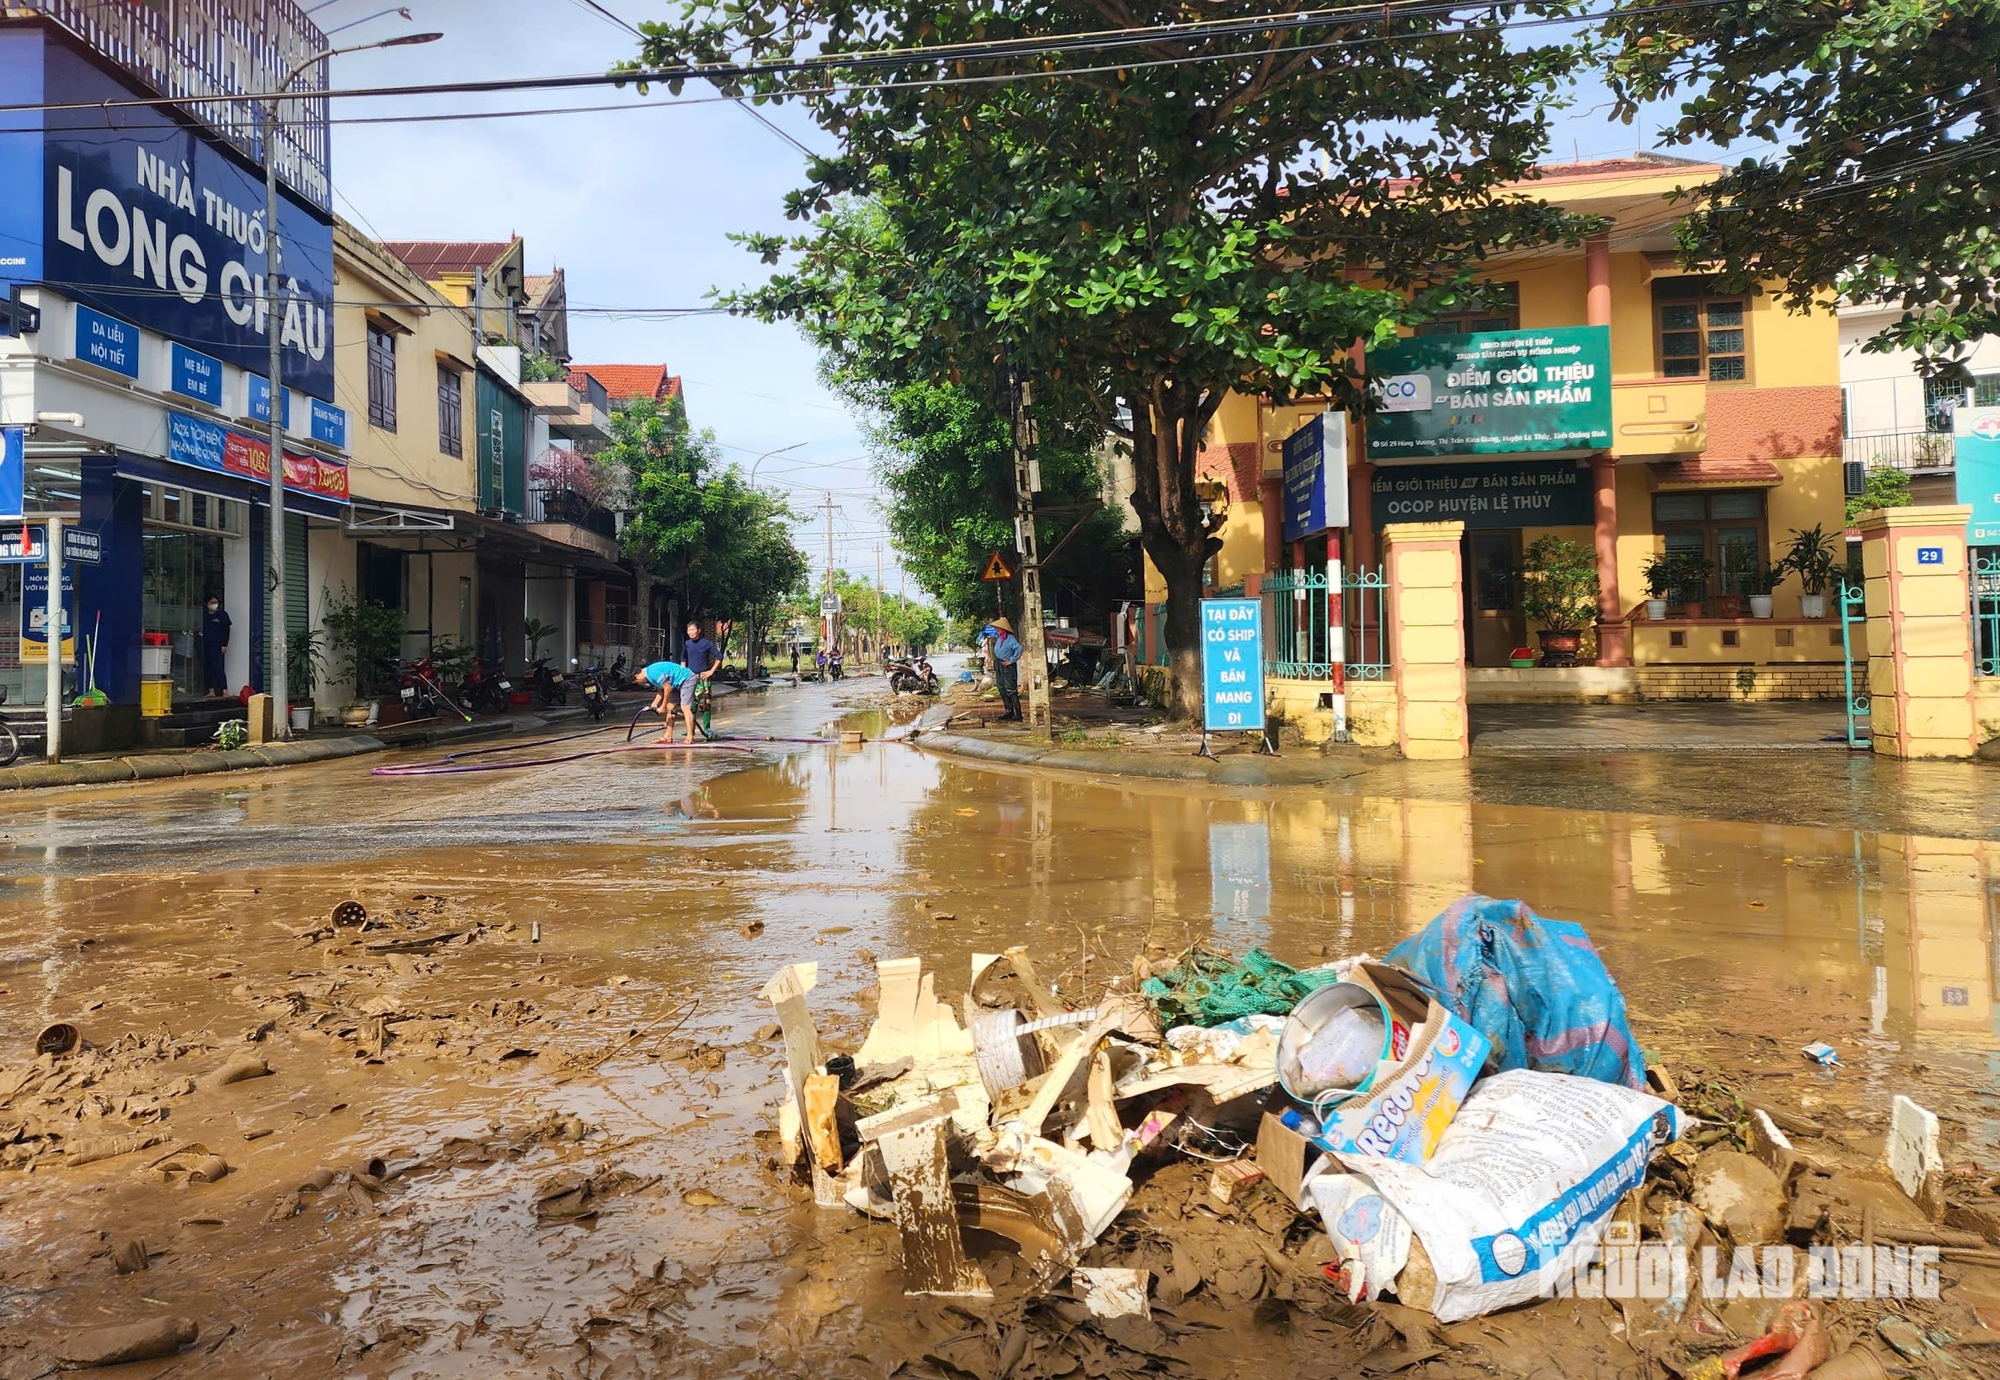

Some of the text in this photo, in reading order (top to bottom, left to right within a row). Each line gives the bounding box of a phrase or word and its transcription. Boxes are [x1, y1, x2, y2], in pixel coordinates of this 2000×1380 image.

[137, 146, 197, 217] NHÀ
[58, 165, 326, 361] LONG CHÂU
[92, 321, 125, 344] DA LIỄU
[91, 343, 126, 367] NỘI TIẾT
[1456, 352, 1480, 360] TRUNG
[1481, 350, 1497, 359] TÂM
[1497, 350, 1517, 359] DỊCH
[184, 357, 197, 374] MẸ
[1447, 361, 1595, 388] ĐIỂM GIỚI THIỆU
[187, 379, 208, 395] EM BÉ
[1450, 390, 1488, 410] BÁN
[1492, 386, 1531, 408] SẢN
[1534, 380, 1592, 405] PHẨM
[1395, 477, 1423, 491] GIỚI
[1425, 475, 1458, 492] THIỆU
[1482, 473, 1508, 488] BÁN
[1511, 471, 1536, 486] SẢN
[1540, 467, 1576, 485] PHẨM
[1387, 490, 1552, 515] OCOP HUYỆN LỆ THỦY
[1921, 550, 1938, 561] 29
[1207, 605, 1255, 623] TẠI ĐÂY
[1207, 626, 1256, 642] CÓ SHIP
[1224, 647, 1241, 662] VÀ
[1220, 670, 1246, 683] BÁN
[1215, 691, 1253, 704] MANG
[1228, 713, 1241, 725] ĐI
[1459, 1048, 1477, 1068] 24
